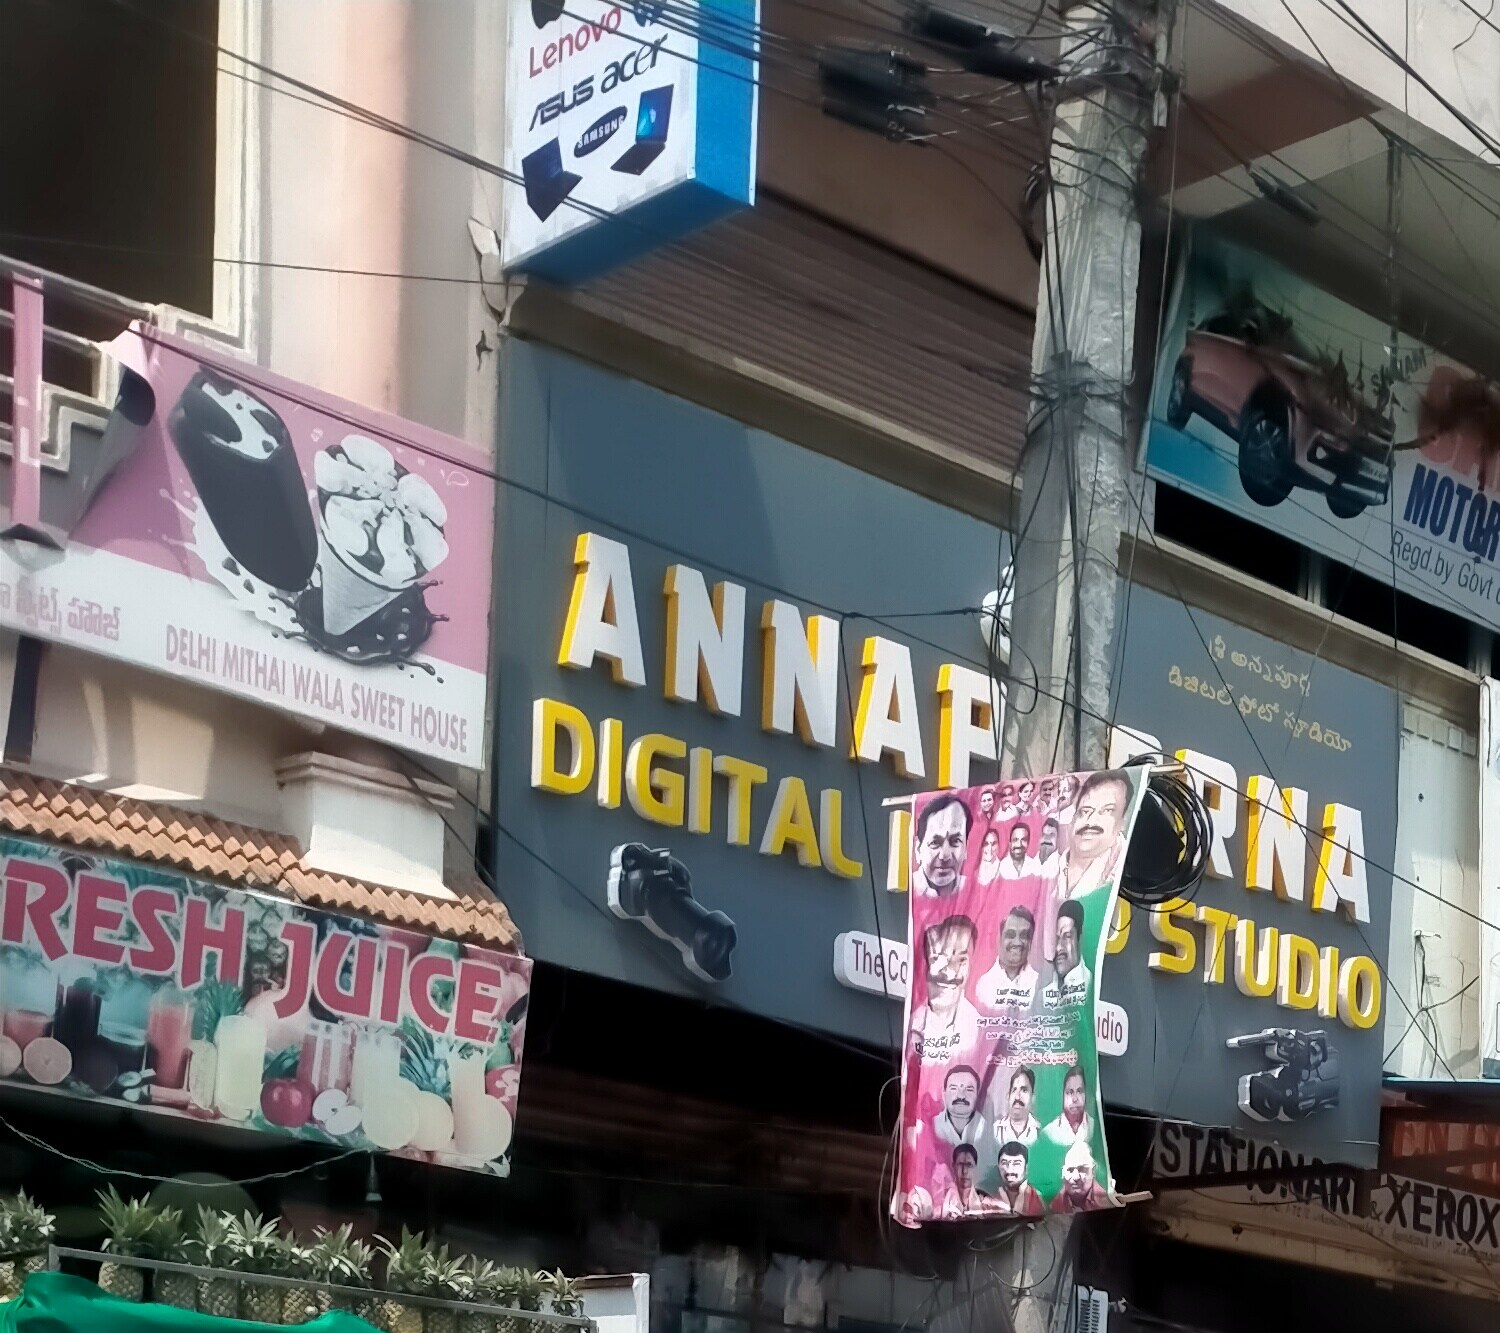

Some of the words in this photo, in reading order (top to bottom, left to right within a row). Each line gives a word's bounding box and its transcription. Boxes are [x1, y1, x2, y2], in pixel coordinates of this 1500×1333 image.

[529, 7, 621, 78] Lenovo
[529, 75, 594, 132] ASUS
[601, 33, 668, 93] acer
[577, 115, 624, 149] SAMSUNG
[1458, 564, 1492, 600] Govt
[166, 624, 216, 673] DELHI
[222, 644, 286, 695] MITHAI
[292, 665, 345, 715] WALA
[350, 682, 405, 733] SWEET
[410, 704, 468, 753] HOUSE
[530, 697, 864, 880] DIGITAL
[274, 920, 504, 1044] JUICE
[852, 939, 883, 977] The
[1148, 896, 1382, 1031] STUDIO
